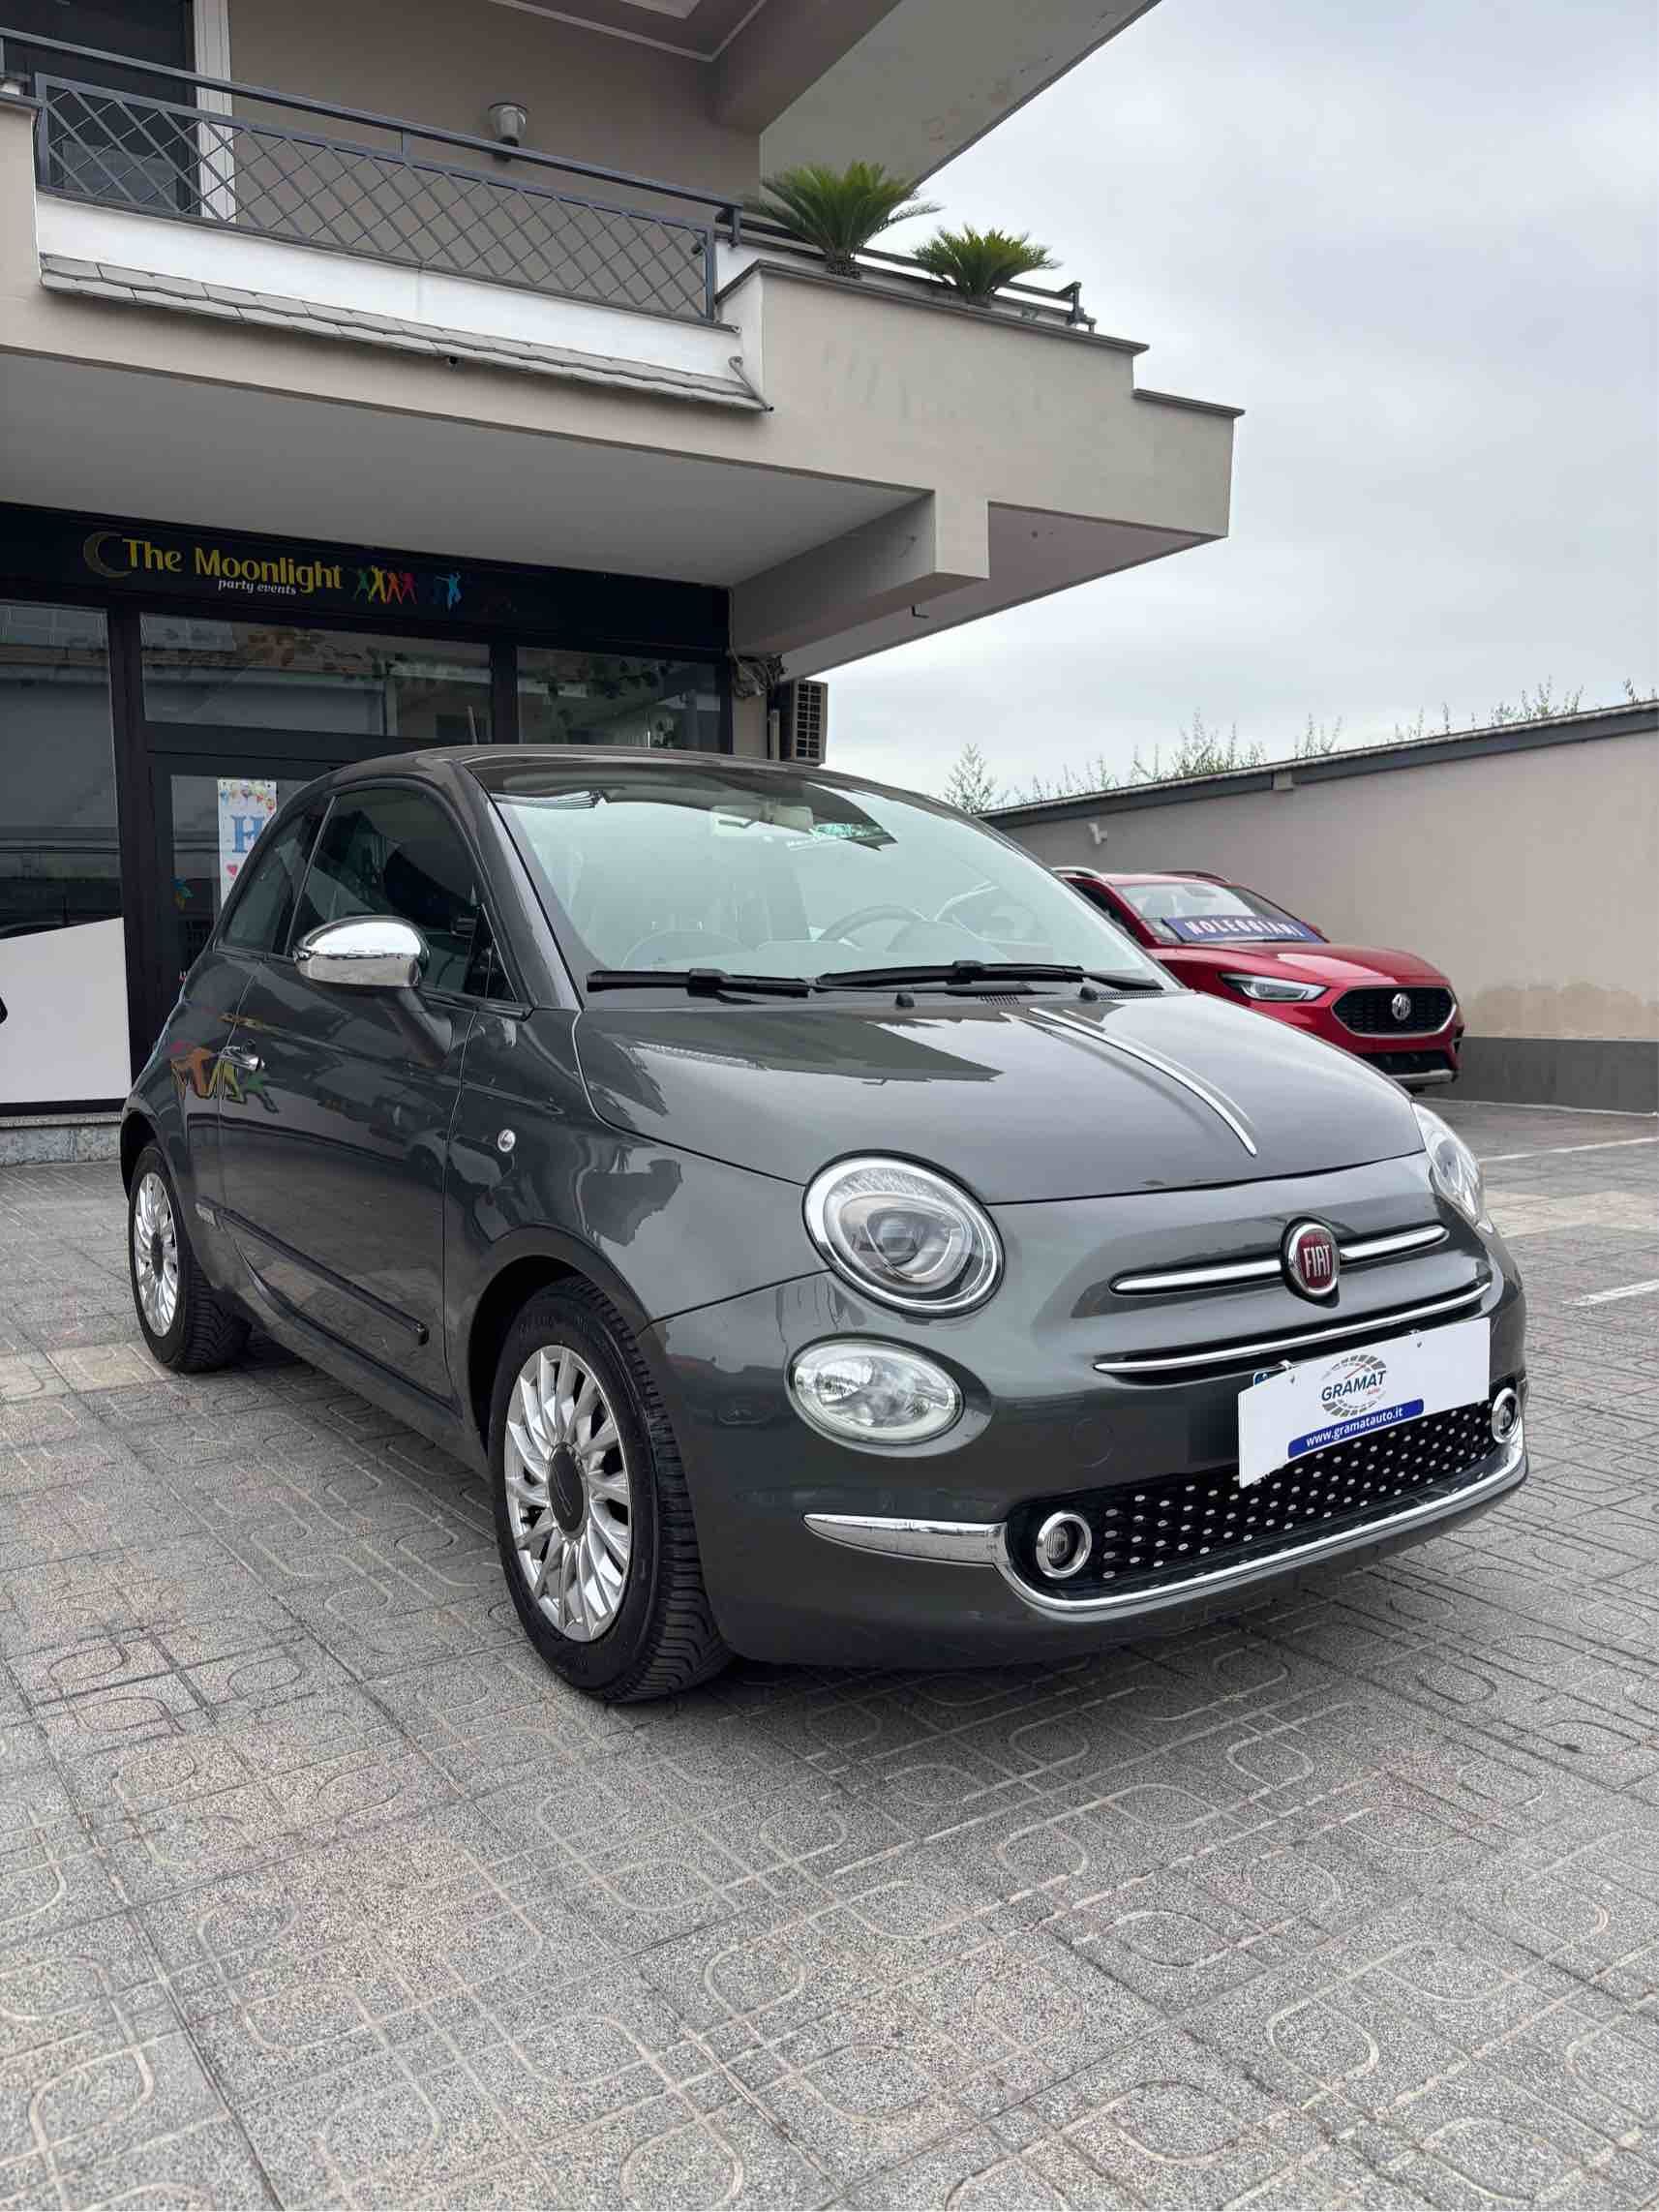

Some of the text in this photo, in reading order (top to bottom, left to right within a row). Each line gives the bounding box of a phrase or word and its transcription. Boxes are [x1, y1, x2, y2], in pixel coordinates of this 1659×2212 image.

[122, 537, 343, 593] The Moonlight
[218, 580, 297, 595] party events
[1303, 1245, 1330, 1278] FIAT
[1321, 1371, 1386, 1402] GRAMAT
[1307, 1407, 1403, 1447] www.gramatauto.it
